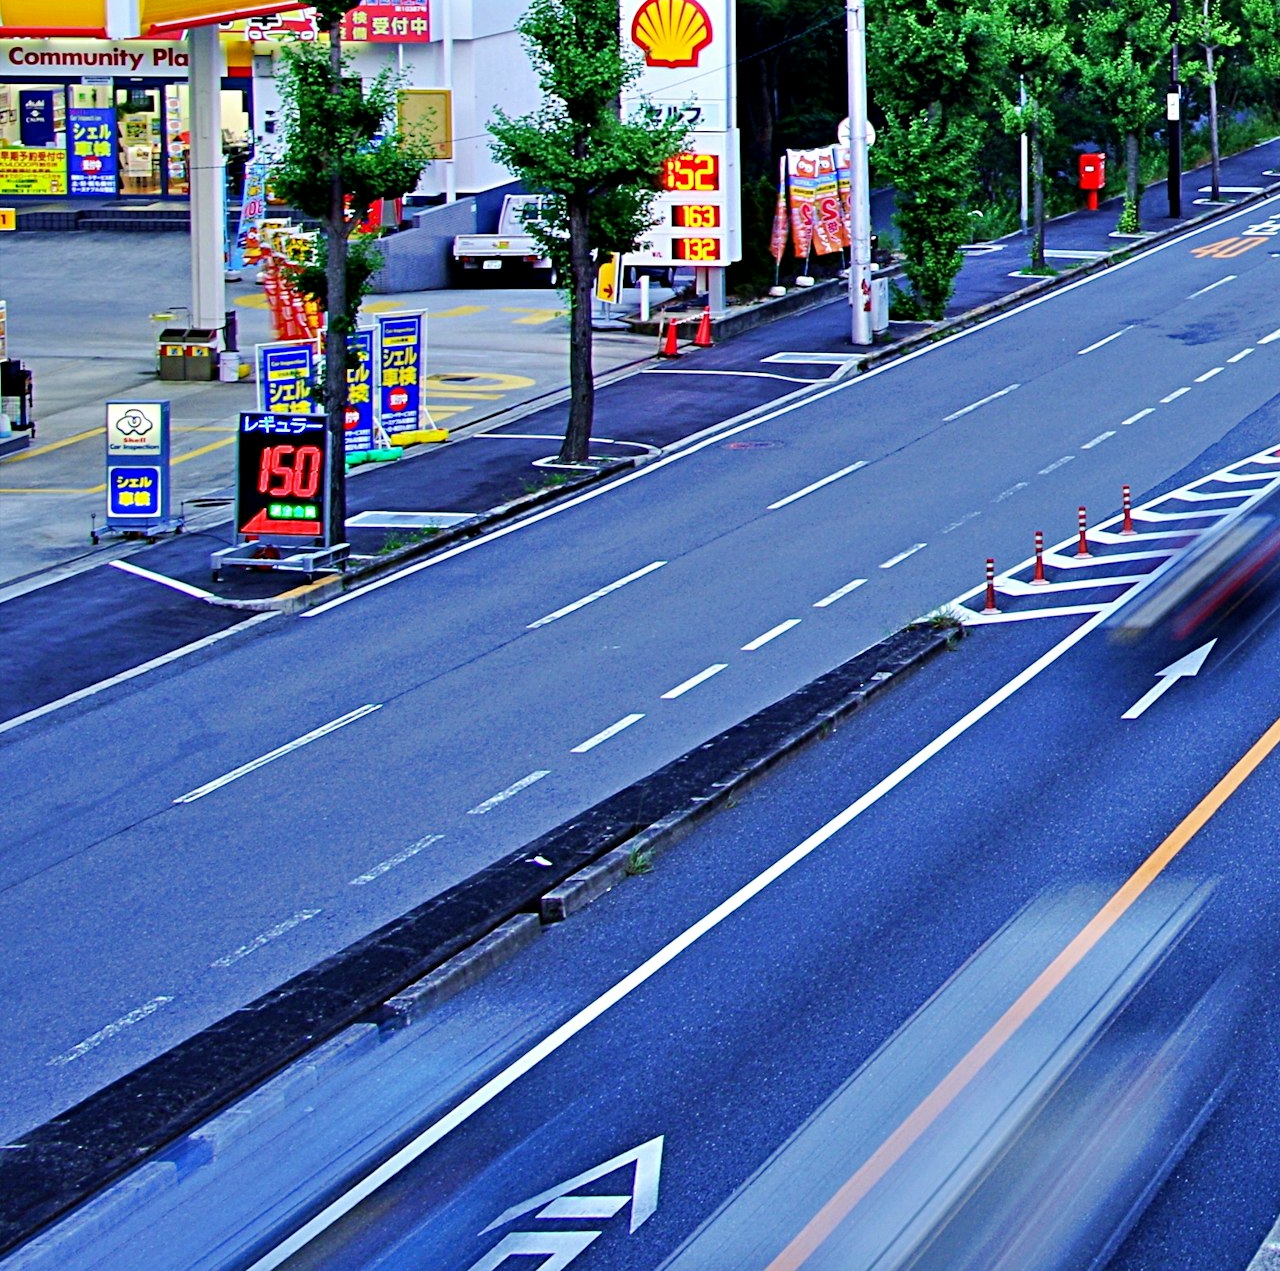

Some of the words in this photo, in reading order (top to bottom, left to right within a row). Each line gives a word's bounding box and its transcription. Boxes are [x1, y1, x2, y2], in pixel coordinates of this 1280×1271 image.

[372, 17, 428, 35] 受付中
[8, 47, 145, 71] Community
[73, 123, 111, 140] シェル
[667, 155, 714, 190] 152
[683, 205, 715, 227] 163
[683, 238, 716, 260] 132
[1190, 237, 1269, 258] 40
[383, 346, 417, 367] シェル
[382, 366, 417, 387] 車検
[269, 380, 310, 403] シェル
[245, 416, 323, 433] レギュラー
[259, 445, 321, 497] 150
[116, 476, 153, 489] シェル
[118, 491, 151, 506] 車検
